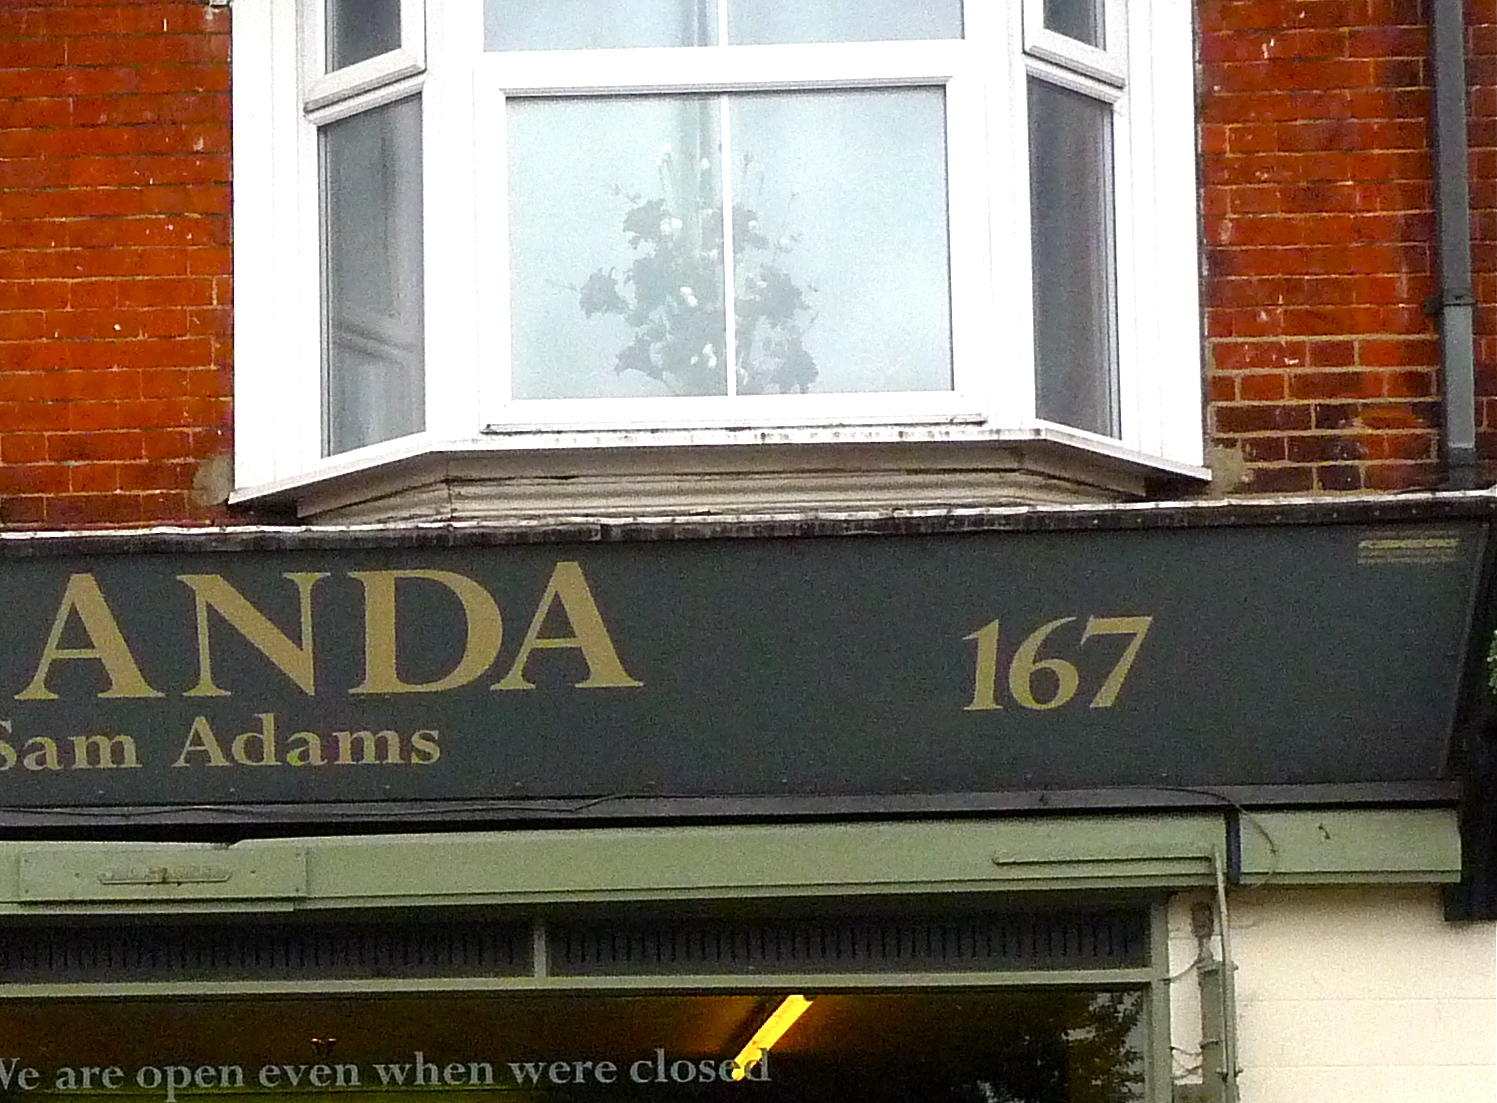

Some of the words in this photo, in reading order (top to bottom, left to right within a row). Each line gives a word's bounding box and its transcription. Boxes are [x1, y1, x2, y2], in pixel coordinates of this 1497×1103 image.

[962, 615, 1154, 712] 167
[171, 712, 441, 768] Adams
[55, 1064, 125, 1090] are
[136, 1063, 245, 1103] open
[258, 1062, 362, 1088] even
[373, 1050, 495, 1087] when
[507, 1059, 618, 1086] were
[629, 1047, 773, 1083] closed
